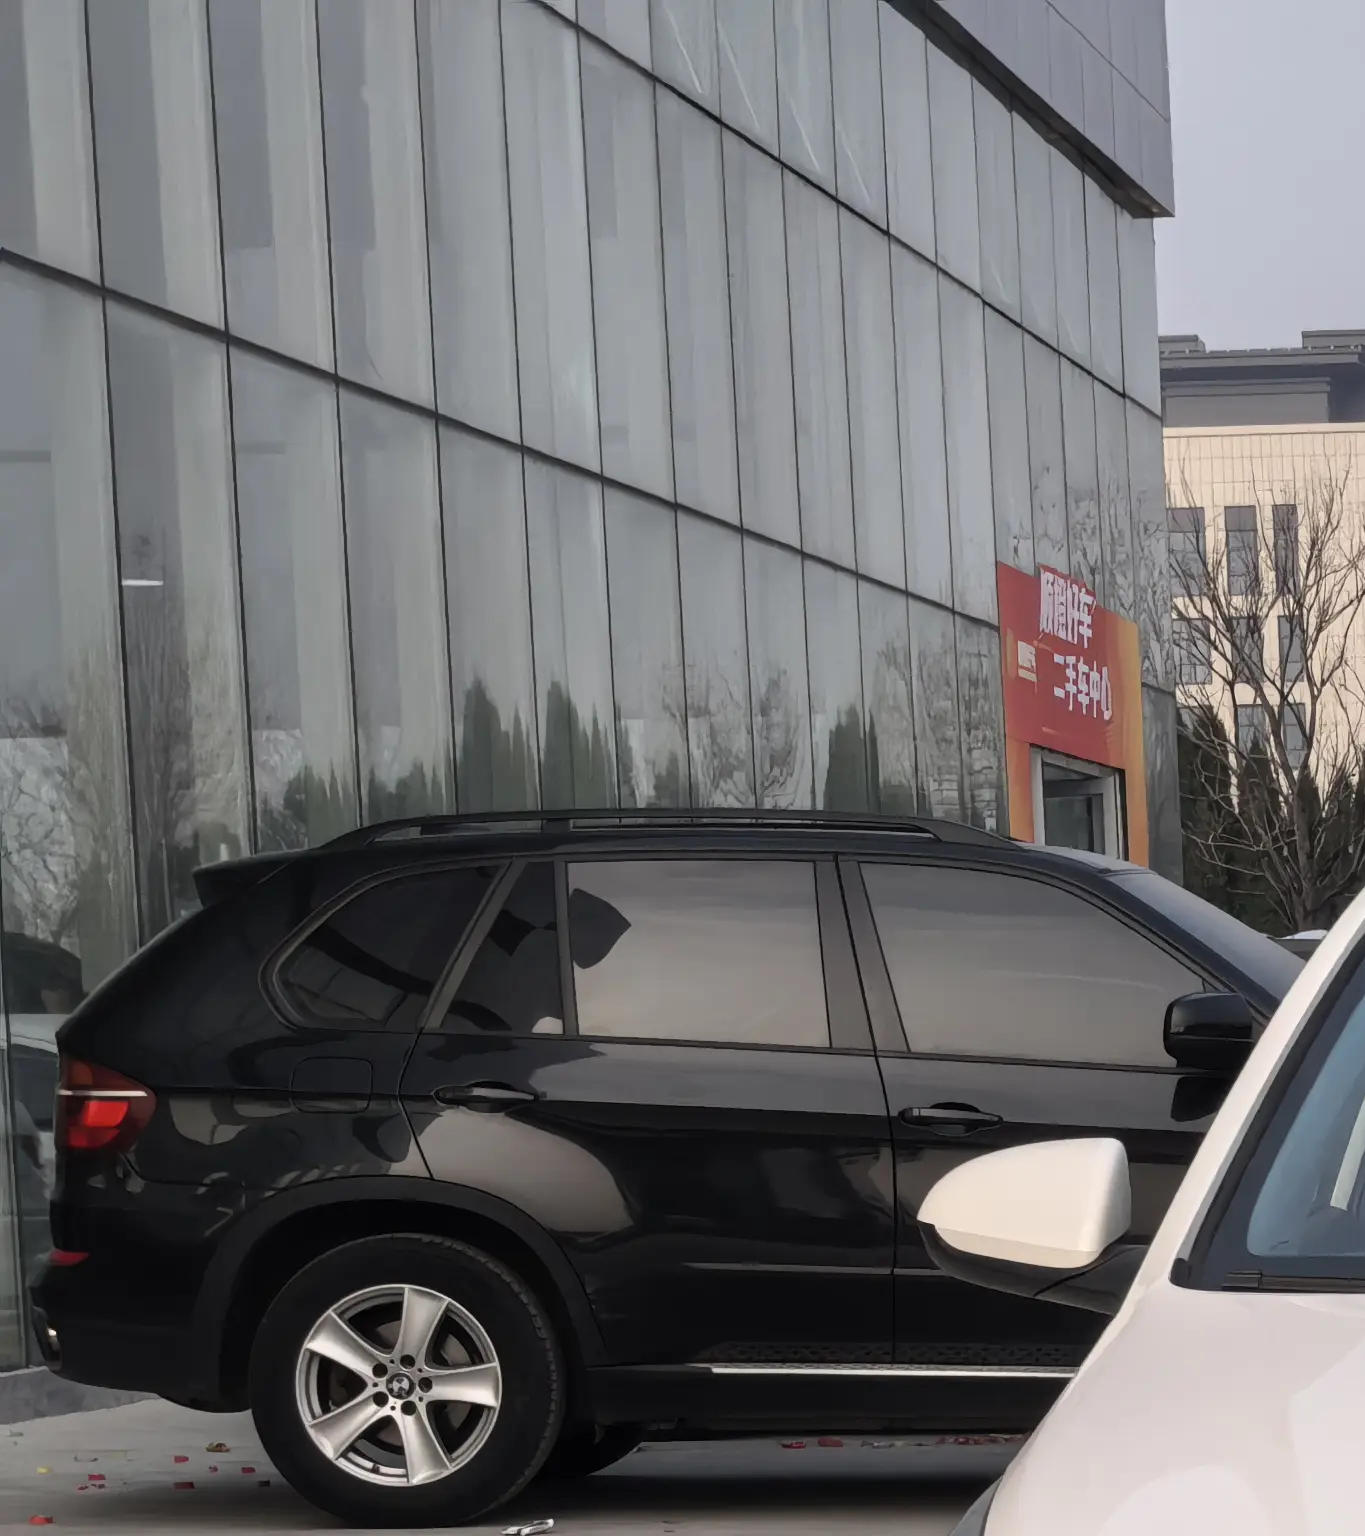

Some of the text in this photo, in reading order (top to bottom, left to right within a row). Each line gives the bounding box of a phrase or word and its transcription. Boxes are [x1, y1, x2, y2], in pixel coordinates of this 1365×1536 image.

[1053, 653, 1112, 721] 二手车中心
